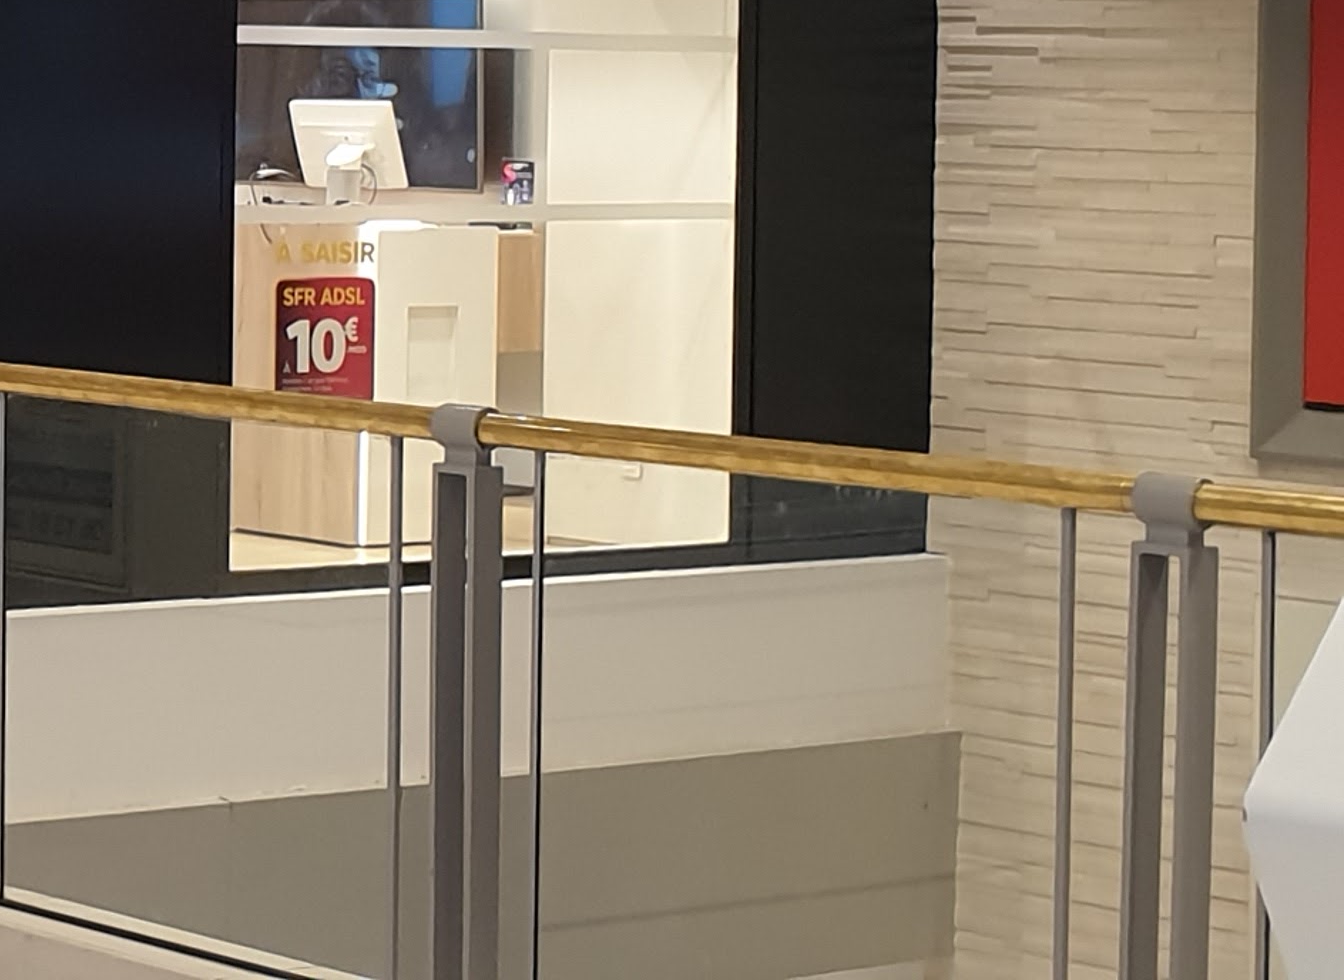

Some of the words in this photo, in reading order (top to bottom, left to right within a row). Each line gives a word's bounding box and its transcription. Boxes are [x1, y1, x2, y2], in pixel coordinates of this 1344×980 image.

[301, 240, 375, 264] SAISIR
[283, 287, 316, 306] SFR
[320, 287, 365, 306] ADSL
